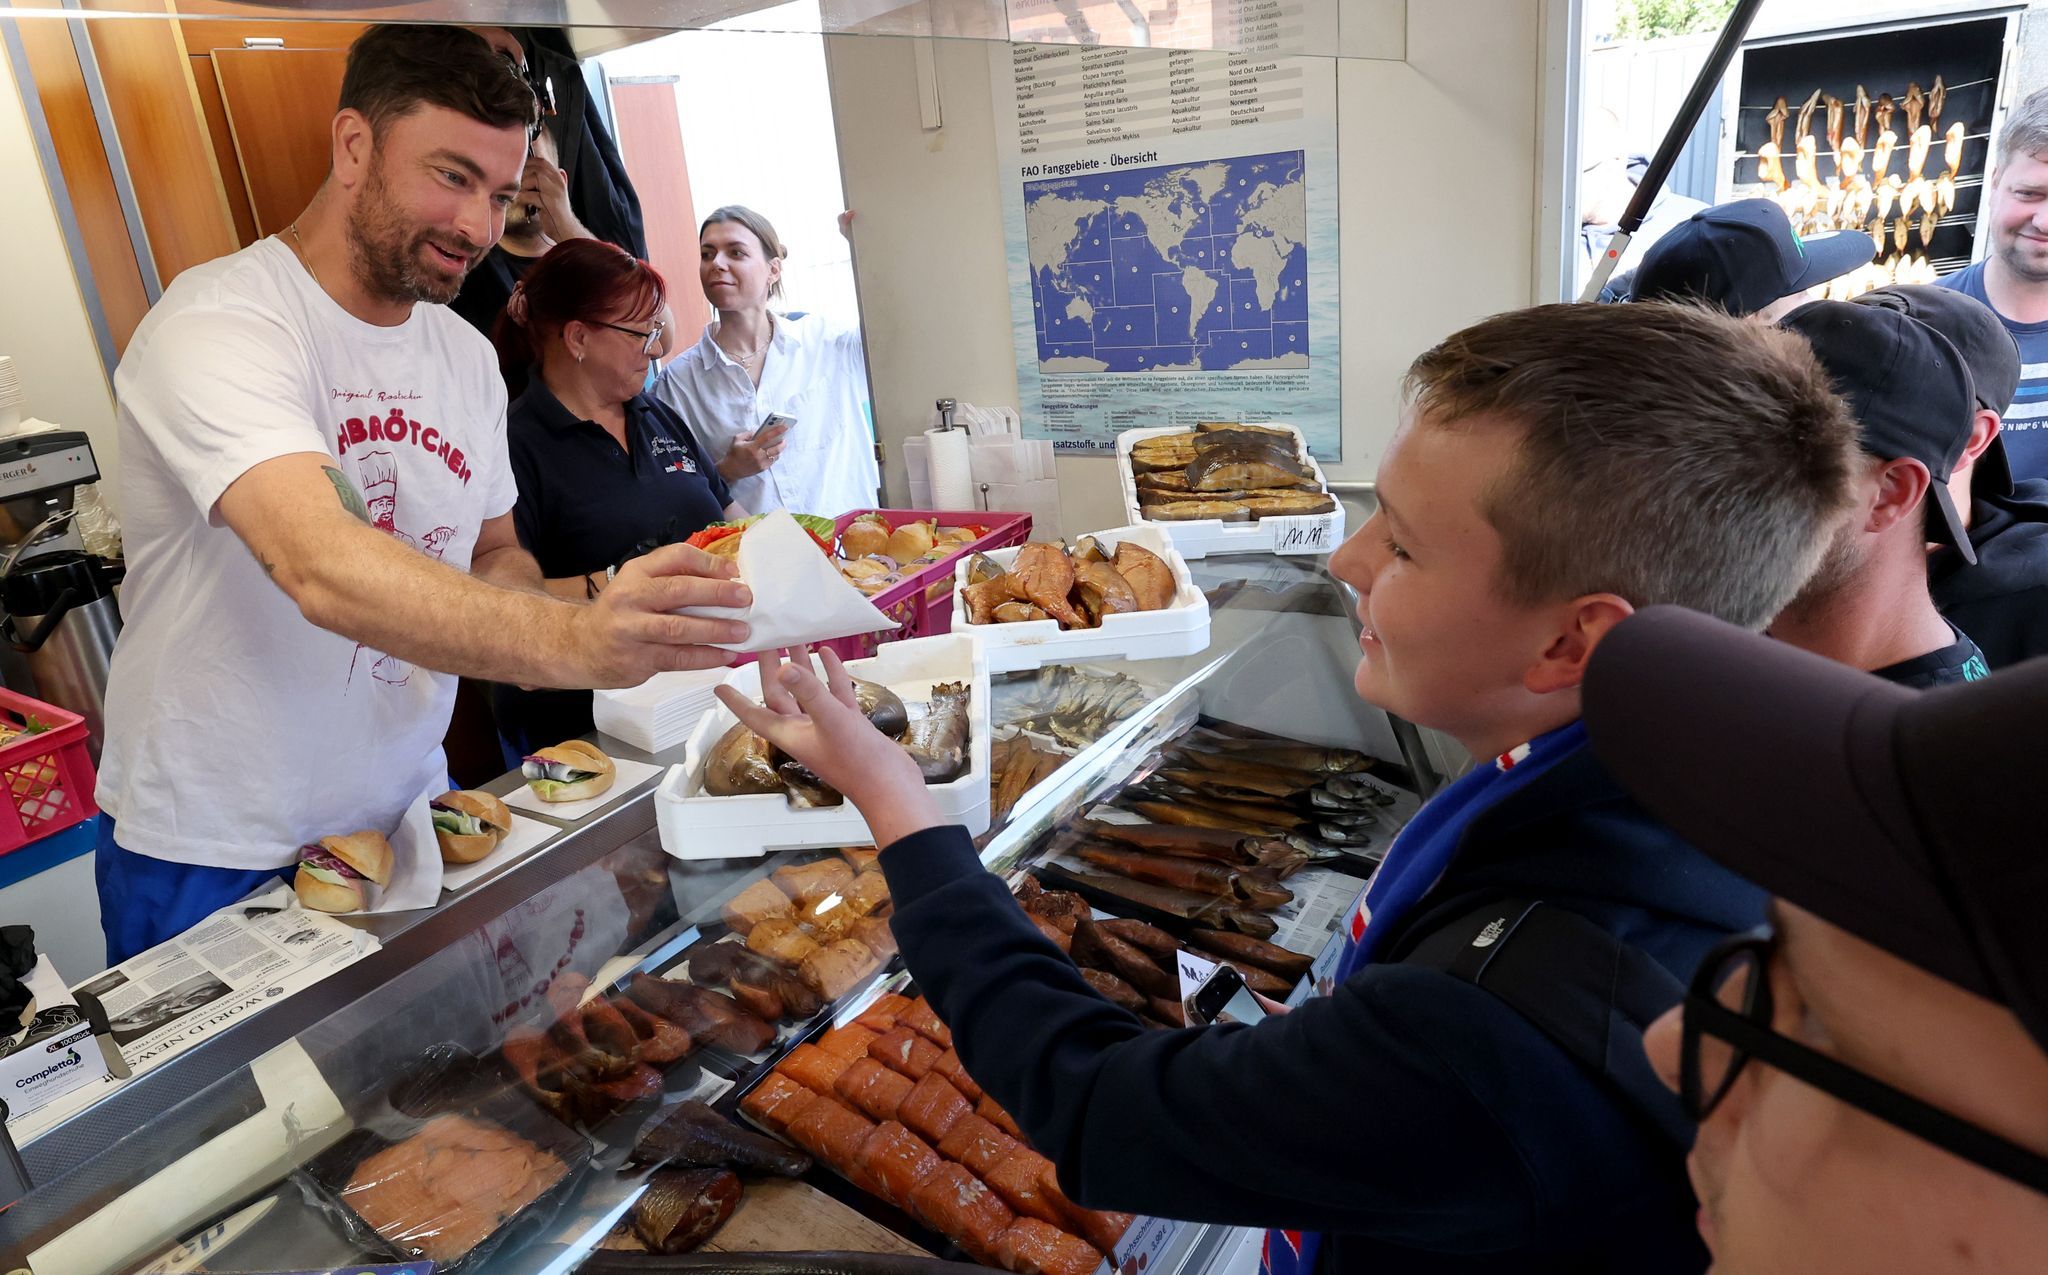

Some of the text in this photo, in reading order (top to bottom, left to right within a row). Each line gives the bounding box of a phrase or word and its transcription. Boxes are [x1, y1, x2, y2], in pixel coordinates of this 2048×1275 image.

[1081, 54, 1102, 62] Scomber
[1169, 57, 1194, 67] gefangen
[1228, 59, 1248, 67] Ostsee
[1170, 67, 1195, 77] gefangen
[1229, 68, 1242, 76] Nord
[1255, 63, 1278, 72] Atlantik
[1083, 69, 1124, 81] Clupea harengus
[1170, 77, 1195, 87] gefangen
[1229, 77, 1258, 87] Dänemark
[1084, 91, 1104, 99] Anguilla
[1170, 86, 1200, 95] Aquakultur
[1229, 87, 1258, 97] Dänemark
[1084, 101, 1100, 109] Salmo
[1171, 96, 1201, 106] Aquakultur
[1230, 97, 1258, 106] Norwegen
[1018, 109, 1044, 118] Bachforelle
[1172, 105, 1201, 115] Aquakultur
[1230, 106, 1265, 116] Deutschland
[1019, 118, 1047, 127] Lachsforelle
[1086, 119, 1101, 127] Salmo
[1172, 115, 1201, 124] Aquakultur
[1230, 117, 1259, 126] Dänemark
[1086, 128, 1111, 136] Salvelinus
[1172, 125, 1202, 134] Aquakultur
[1122, 133, 1140, 141] Mykiss
[1021, 166, 1039, 177] FAO
[1042, 159, 1099, 175] Fanggebiete
[1110, 152, 1157, 166] Übersicht
[331, 388, 373, 402] Original
[2008, 423, 2015, 431] N
[1099, 440, 1115, 449] und
[127, 997, 262, 1069] WORLD NEWS
[47, 1028, 92, 1053] XL 100 Stück
[16, 1058, 75, 1089] Completto
[24, 1064, 85, 1095] Einweghandschuhe
[1119, 1217, 1156, 1266] Lachsschn
